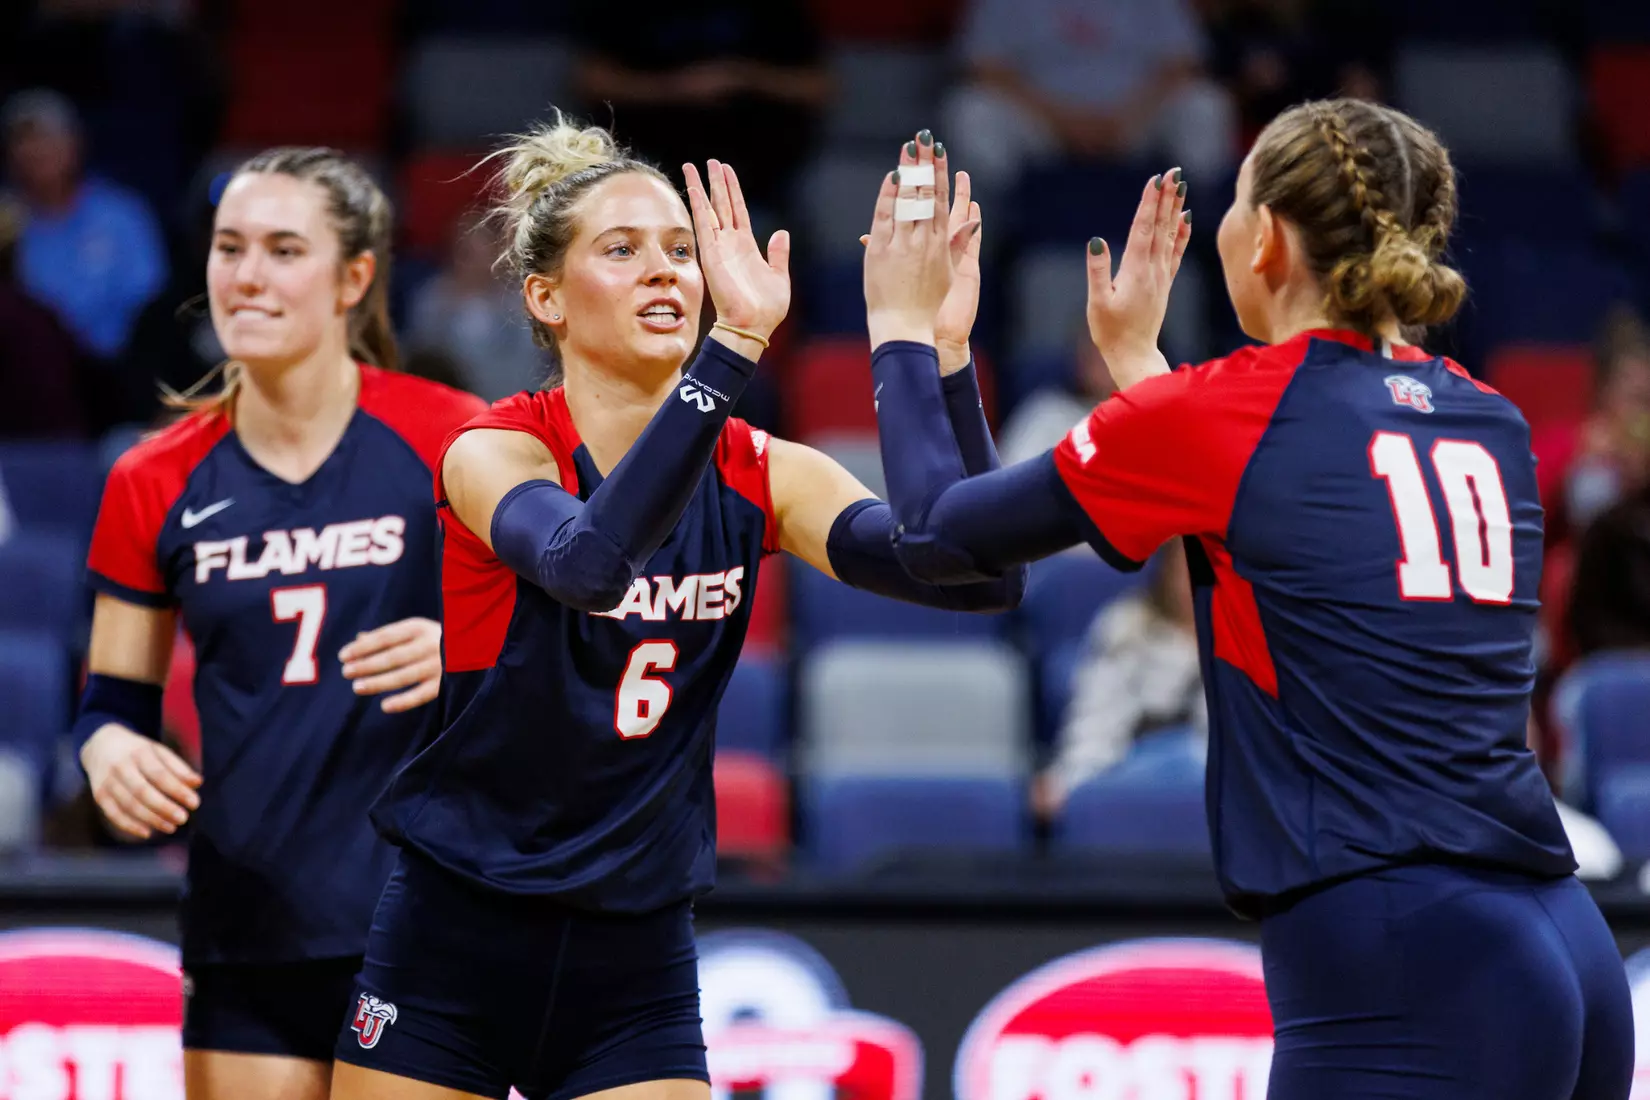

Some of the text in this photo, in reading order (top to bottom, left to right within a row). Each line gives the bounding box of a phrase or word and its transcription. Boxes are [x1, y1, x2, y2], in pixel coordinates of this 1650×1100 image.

[193, 515, 406, 584] FLAMES
[1367, 430, 1515, 606] 10
[270, 582, 327, 686] 7
[588, 565, 745, 621] AMES
[614, 638, 680, 741] 6
[350, 993, 388, 1050] LU
